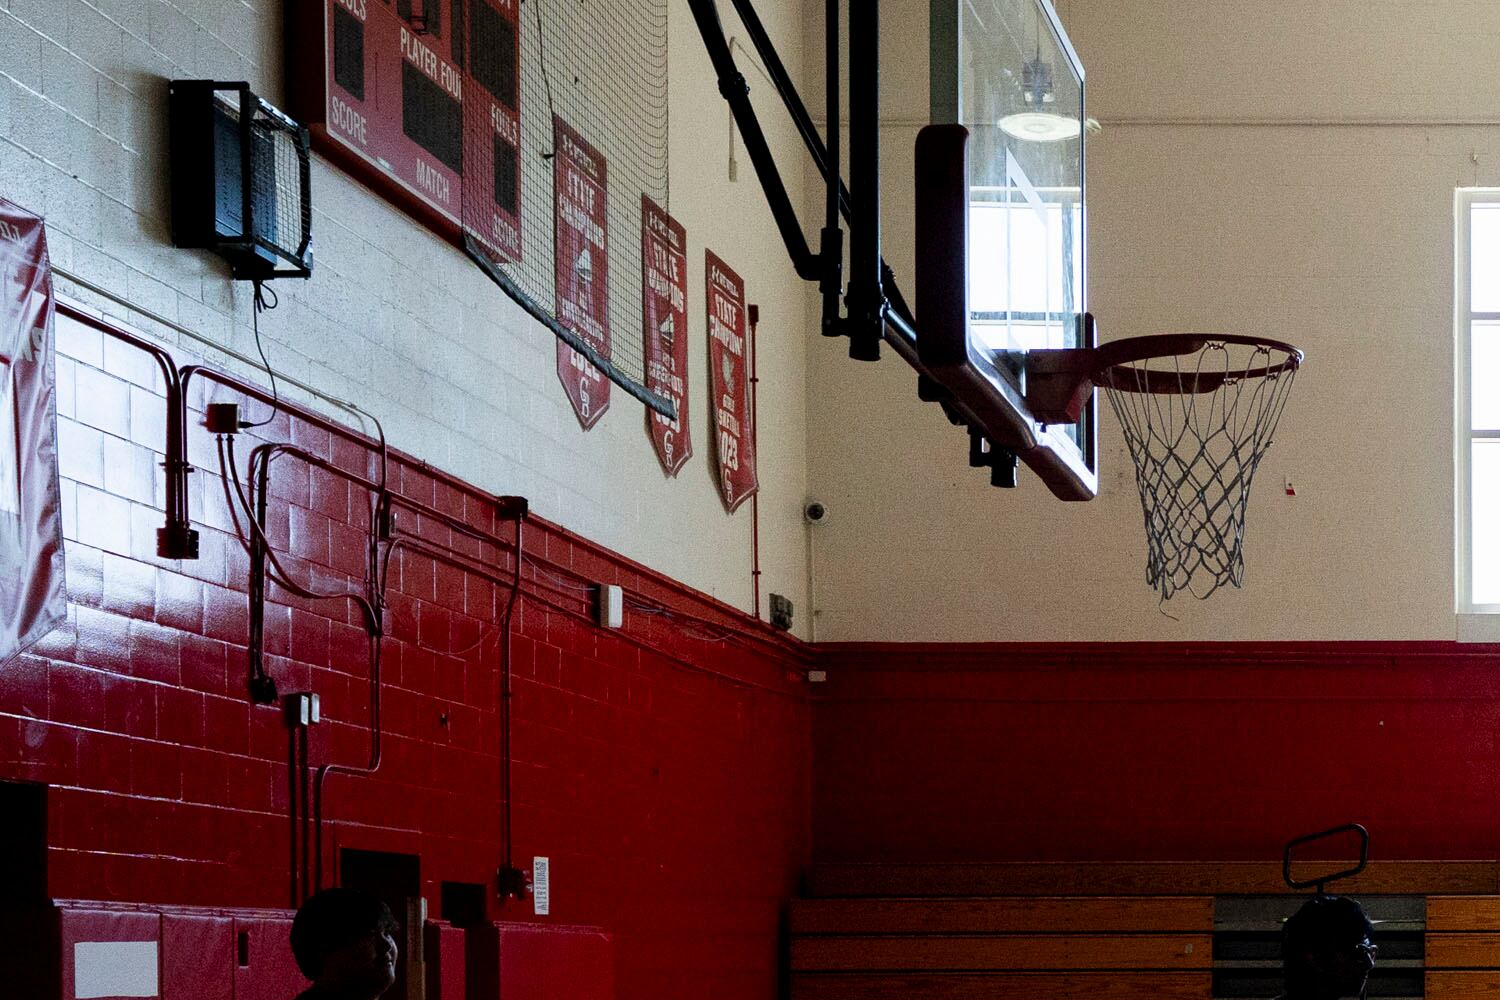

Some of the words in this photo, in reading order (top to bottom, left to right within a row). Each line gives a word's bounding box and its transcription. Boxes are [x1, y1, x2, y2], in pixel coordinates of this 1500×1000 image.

[400, 27, 438, 81] PLAYER
[332, 96, 367, 145] SCORE
[491, 103, 518, 147] FOULS
[416, 158, 450, 204] MATCH
[715, 293, 736, 330] STATE
[720, 430, 739, 471] 023
